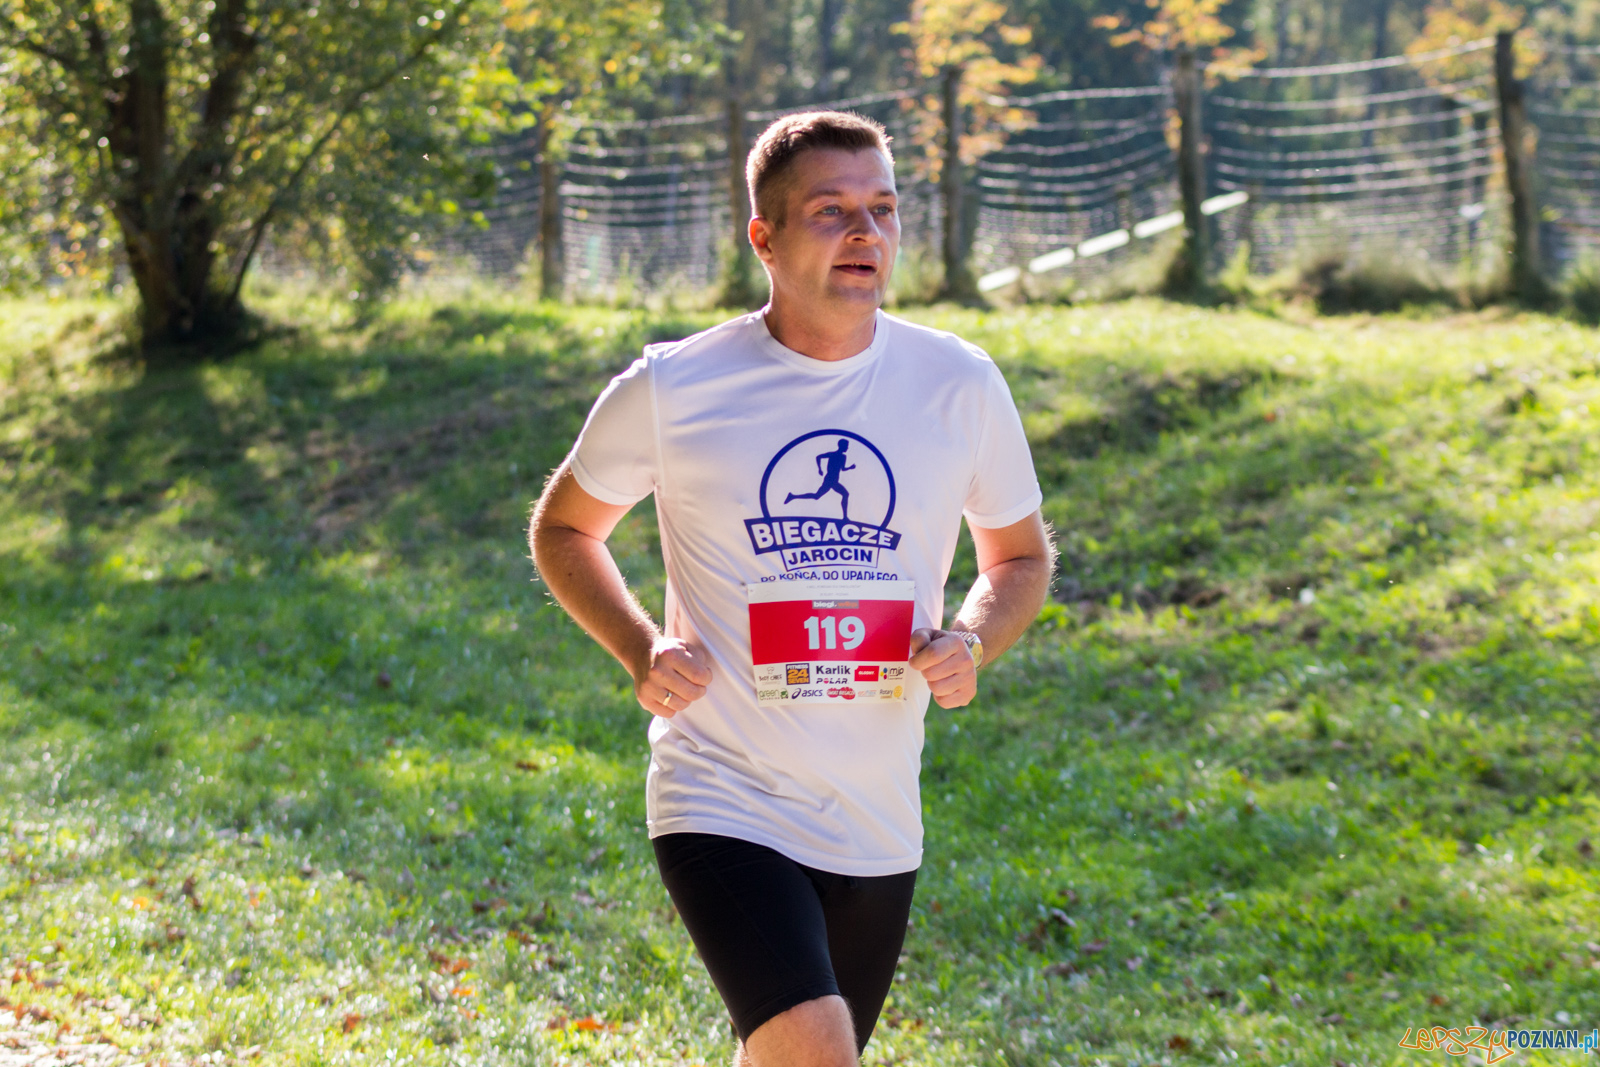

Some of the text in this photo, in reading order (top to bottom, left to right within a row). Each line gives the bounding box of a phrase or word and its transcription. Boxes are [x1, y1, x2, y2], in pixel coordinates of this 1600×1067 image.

[751, 520, 894, 549] BIEGACZE
[788, 548, 873, 565] JAROCIN
[779, 570, 821, 580] KOŃCA,
[823, 570, 839, 580] DO
[803, 615, 866, 650] 119
[787, 669, 809, 678] 24
[816, 665, 851, 675] Karlik
